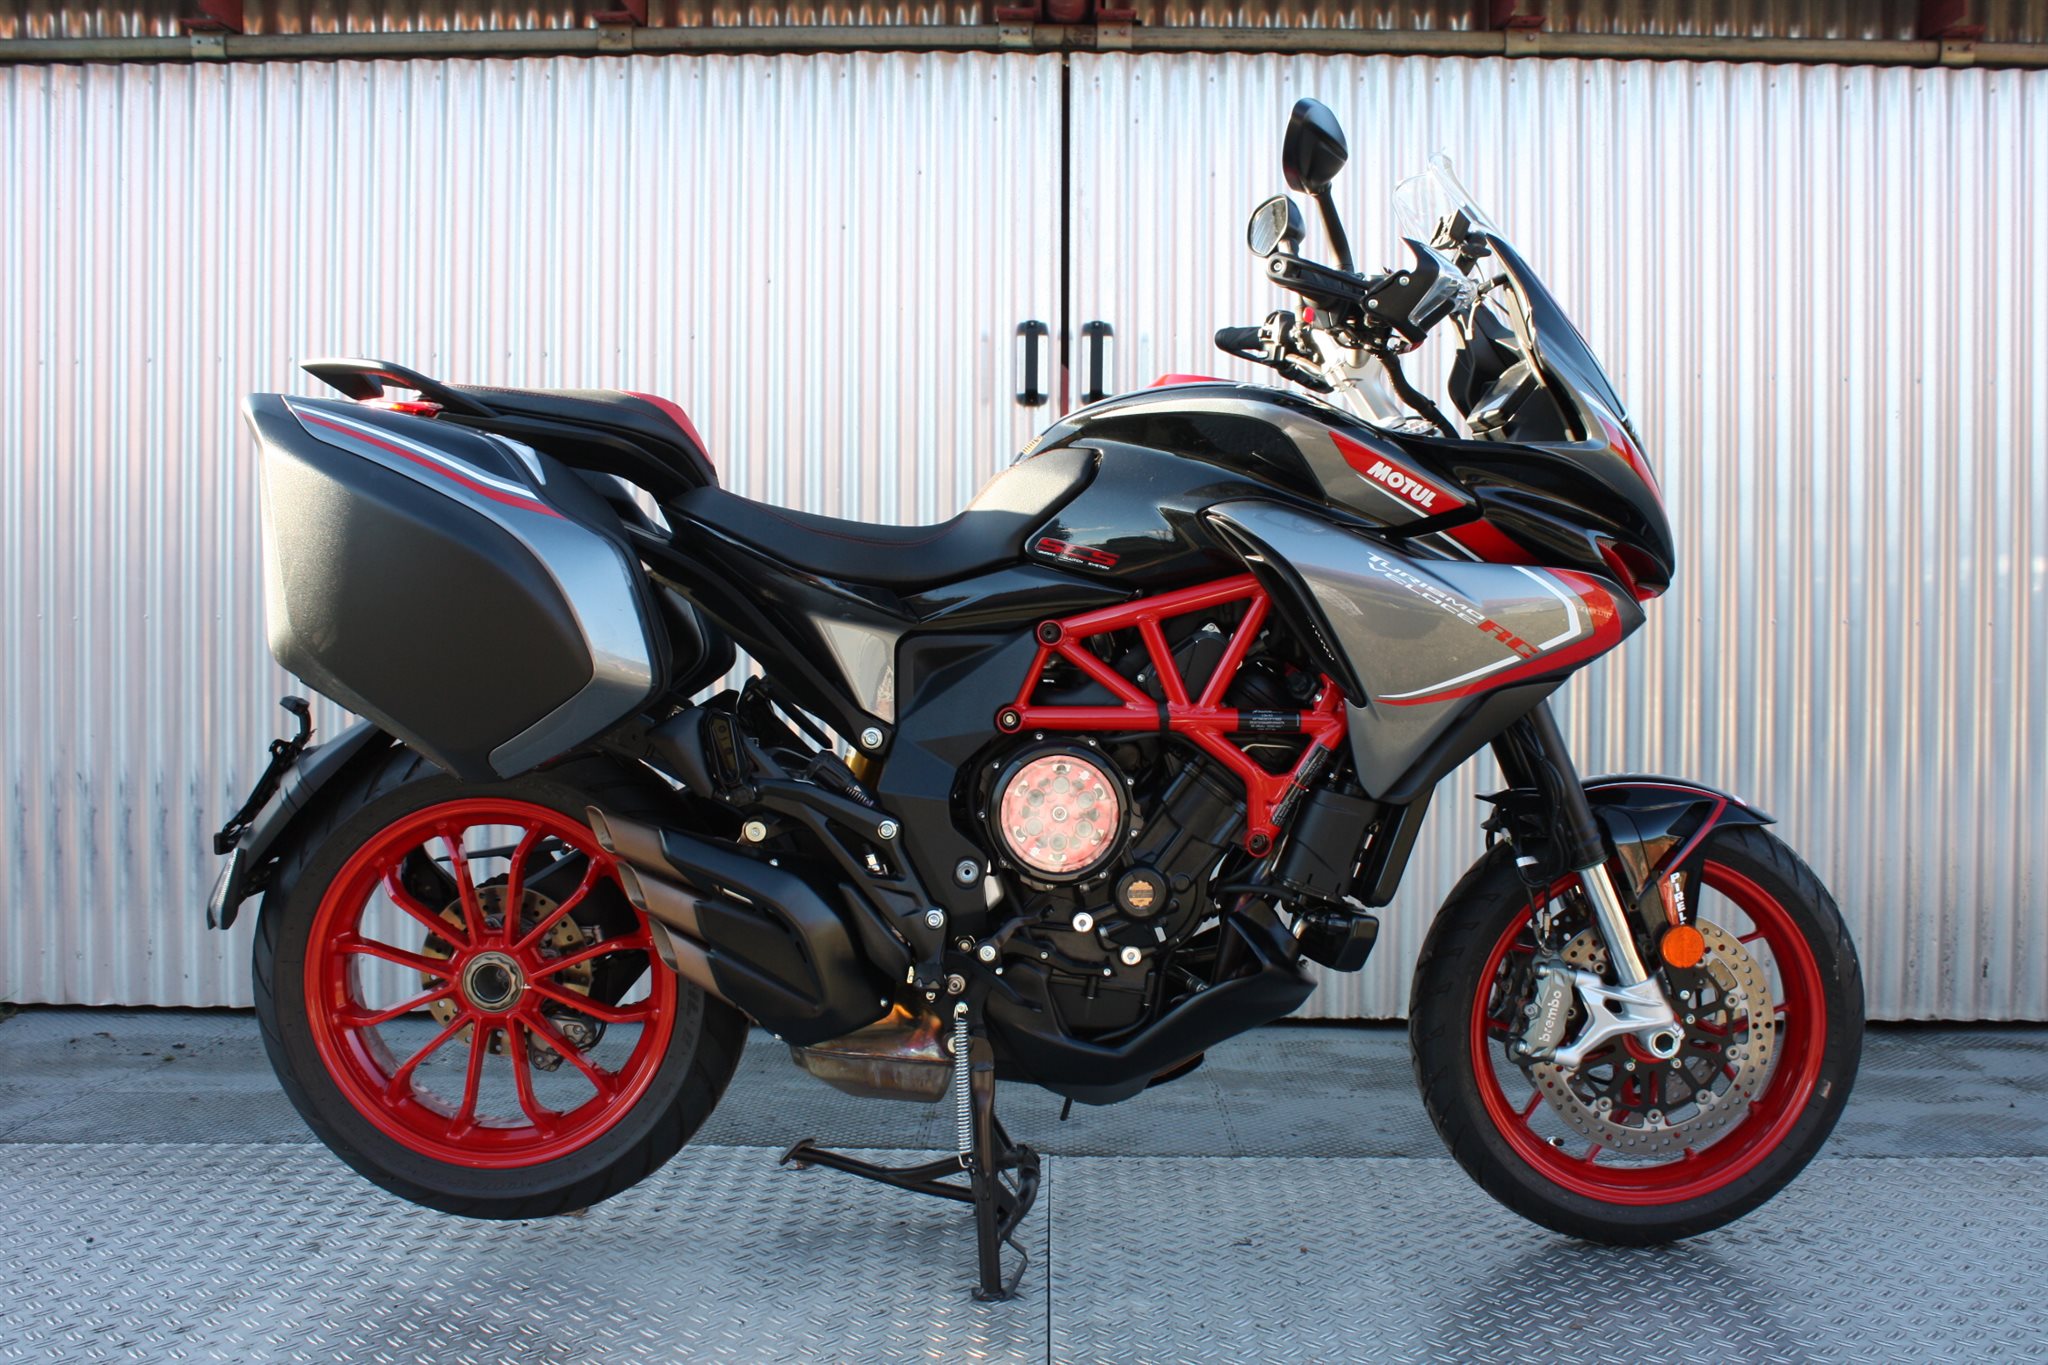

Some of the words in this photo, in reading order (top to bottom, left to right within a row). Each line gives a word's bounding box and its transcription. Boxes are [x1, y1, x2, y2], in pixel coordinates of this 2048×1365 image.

[1366, 460, 1437, 508] MOTUL
[1036, 537, 1121, 567] SCS
[1366, 551, 1486, 621] TURISMO
[1368, 561, 1479, 625] VELOCE
[1478, 618, 1541, 660] RC
[1670, 871, 1687, 926] PIREL
[1538, 990, 1562, 1042] brembo
